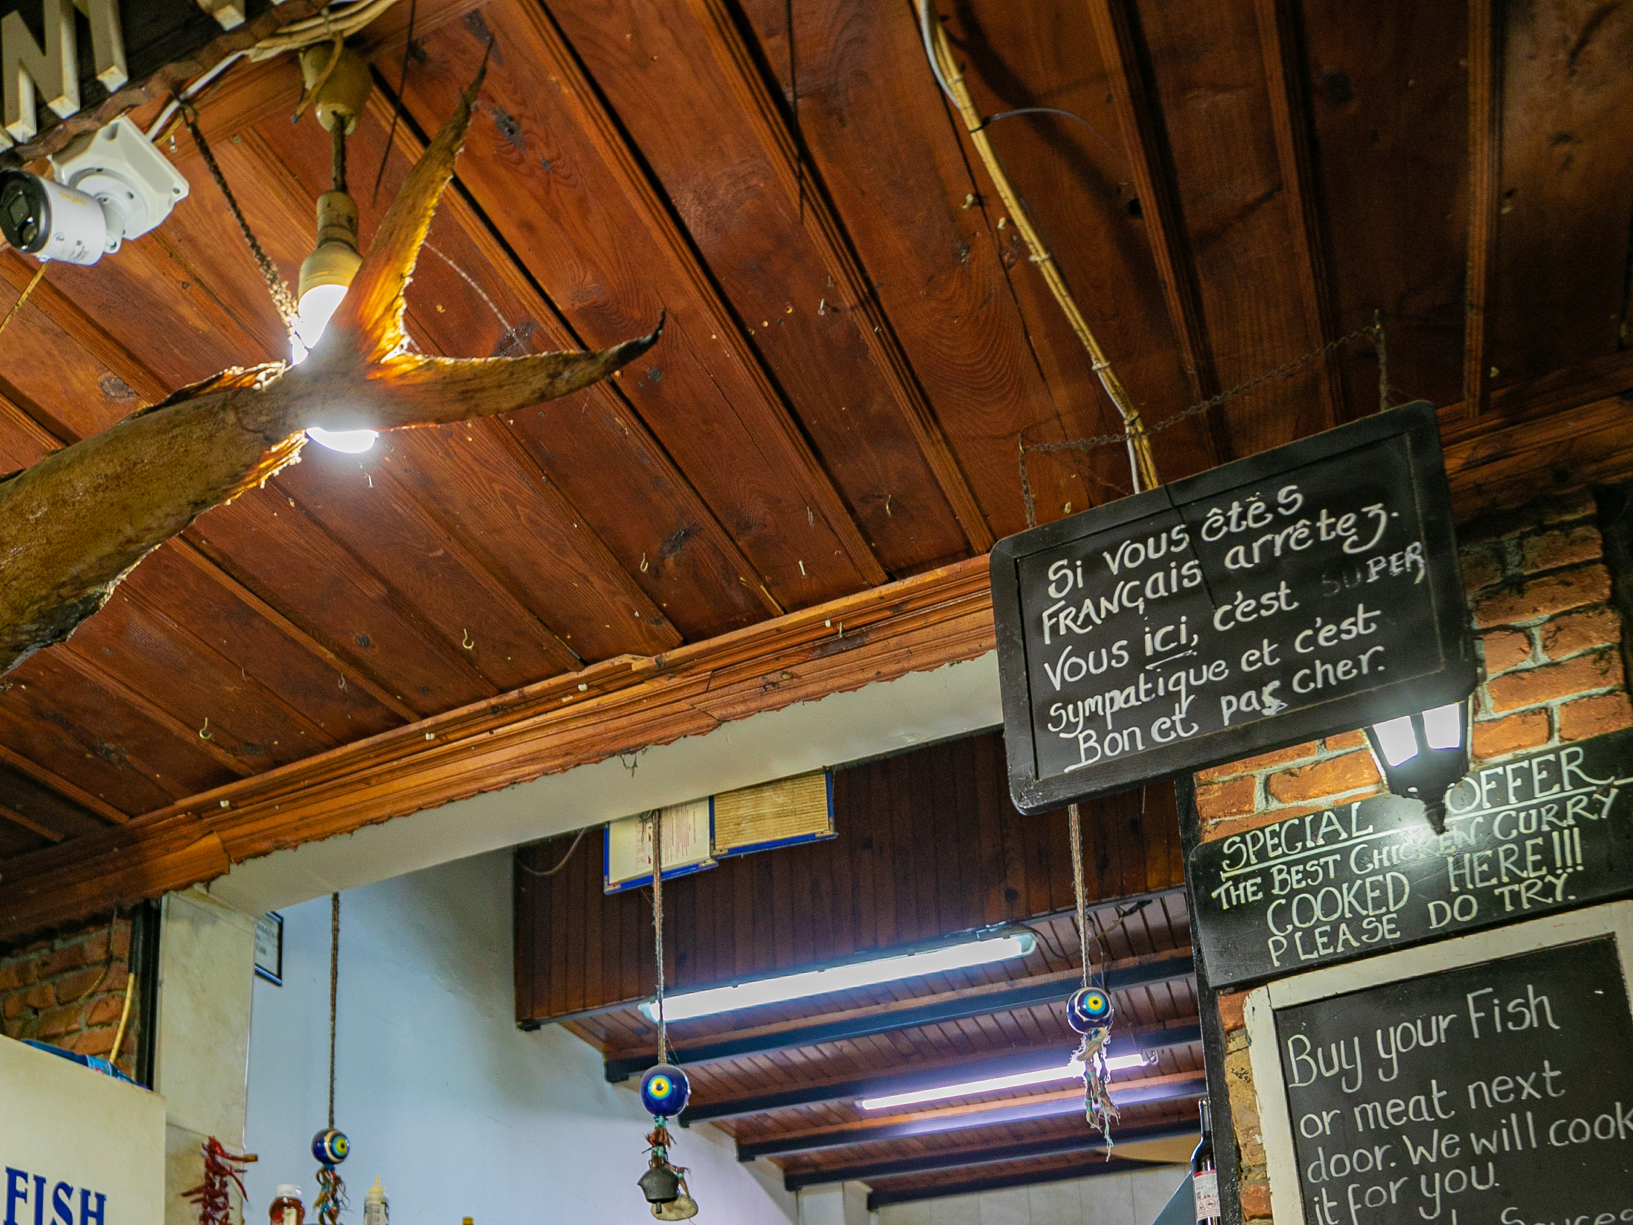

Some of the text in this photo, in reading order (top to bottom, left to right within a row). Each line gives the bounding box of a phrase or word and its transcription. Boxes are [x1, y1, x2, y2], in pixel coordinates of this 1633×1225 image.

[1048, 559, 1084, 599] Si
[1144, 616, 1198, 658] ici,
[1213, 581, 1299, 631] c'est
[1240, 638, 1280, 672] et
[1294, 604, 1382, 654] c'est
[1064, 728, 1145, 773] Bon
[1150, 700, 1200, 743] et
[1220, 680, 1288, 725] pas
[1212, 876, 1263, 910] THE
[1271, 856, 1341, 895] BEST
[1493, 788, 1619, 841] CURRY
[1222, 748, 1615, 870] SPECIAL OFFER
[1267, 828, 1583, 936] COOKED HERE!!!
[1268, 873, 1577, 967] PLEASE DO TRY.
[1287, 984, 1561, 1093] Buy your Fish
[1301, 1060, 1565, 1139] or meat next
[1307, 1102, 1633, 1183] door. We will cook
[1419, 1162, 1500, 1220] you.
